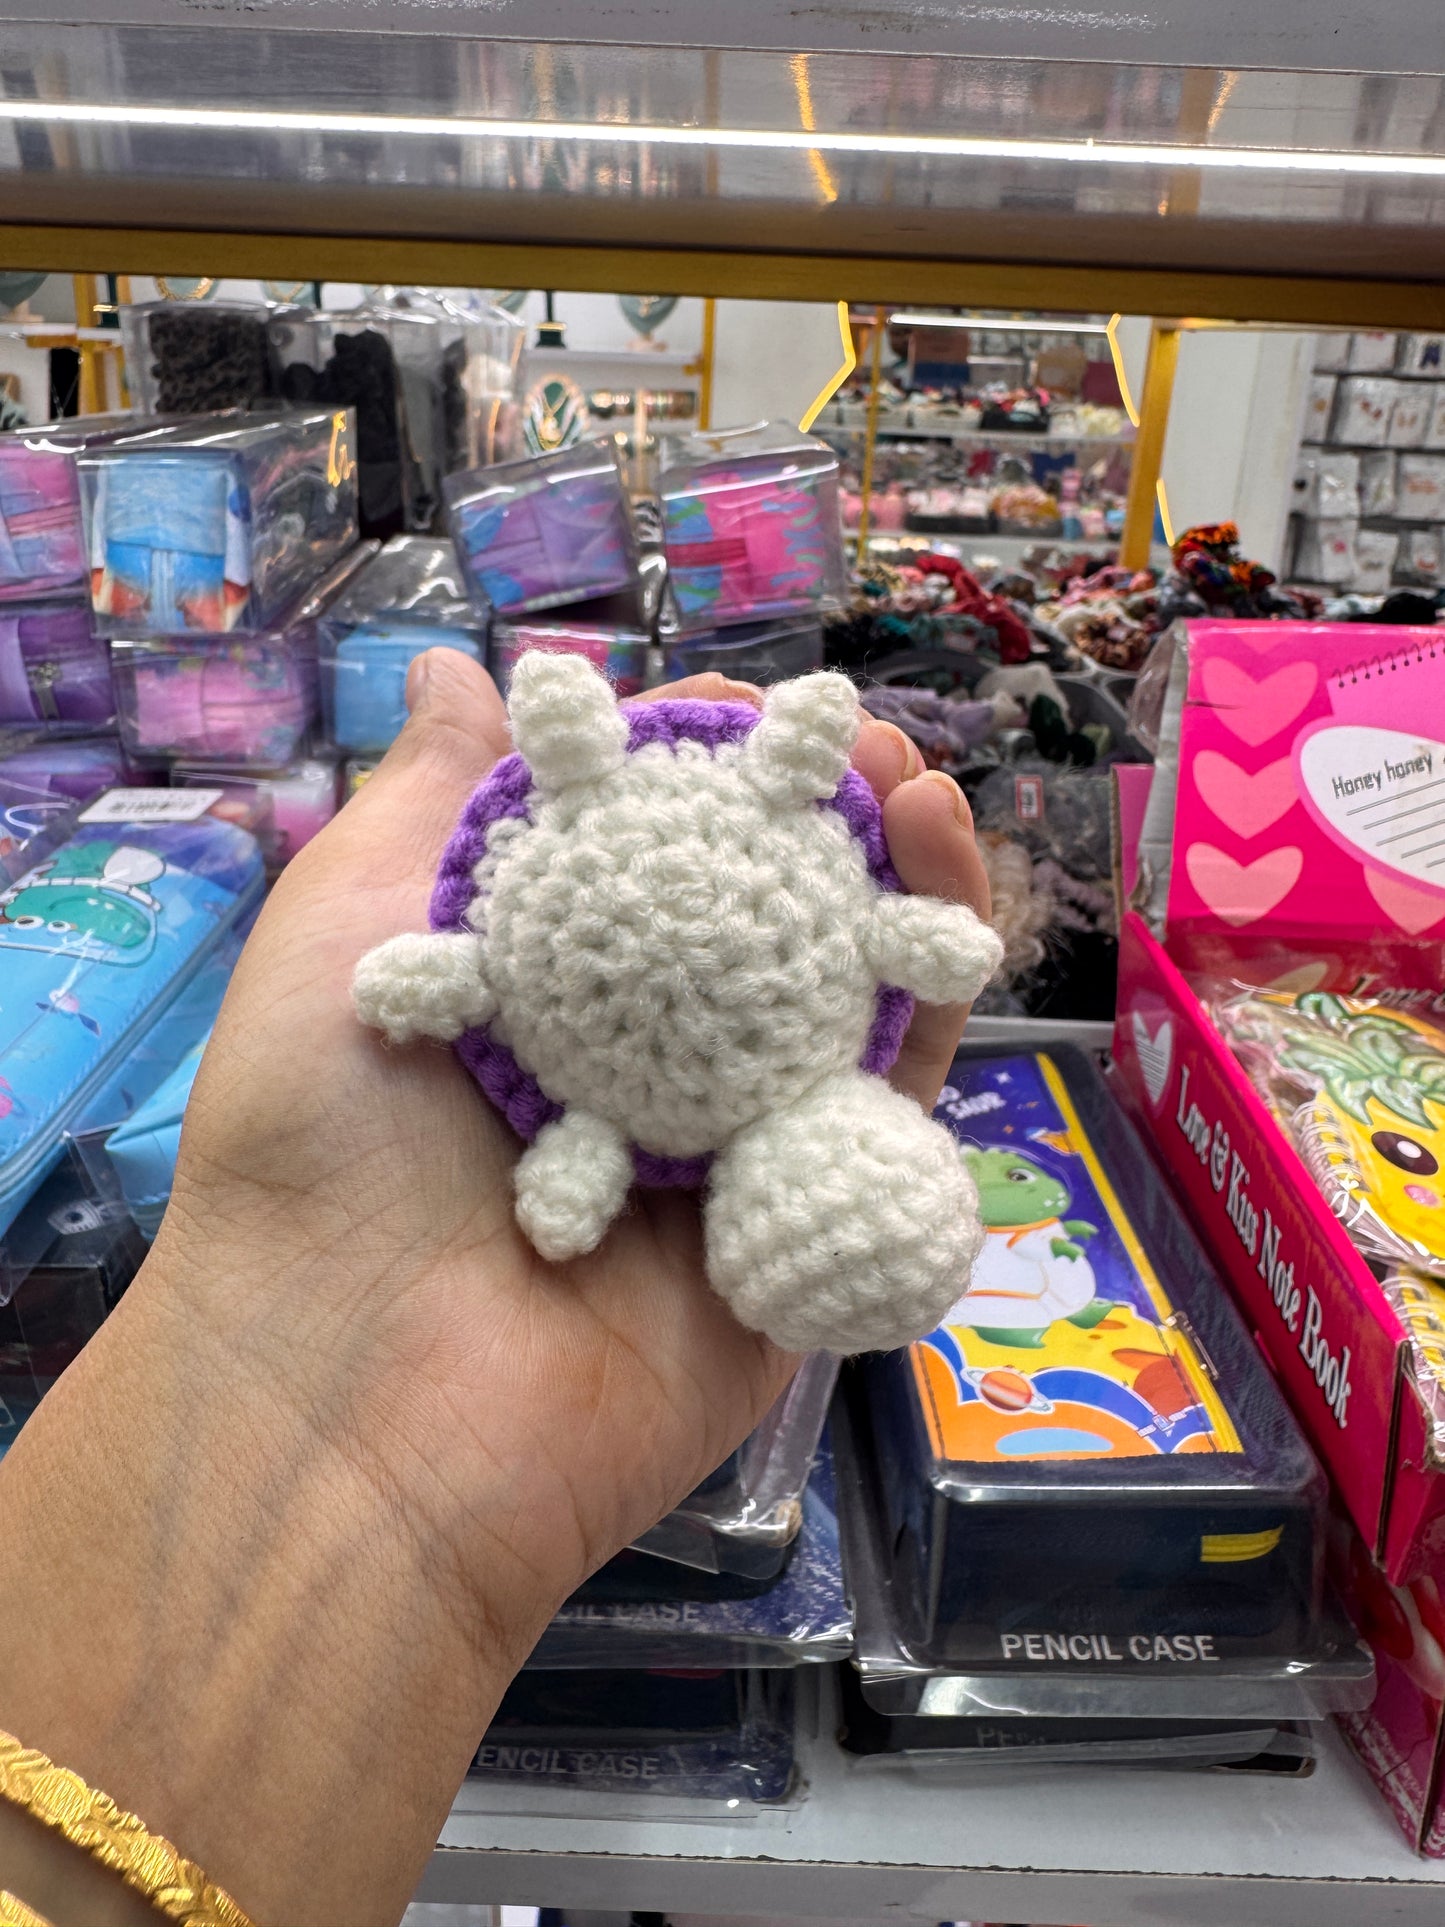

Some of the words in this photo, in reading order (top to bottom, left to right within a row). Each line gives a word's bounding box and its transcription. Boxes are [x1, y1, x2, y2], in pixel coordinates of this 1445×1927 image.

[1332, 769, 1381, 799] Honey
[1384, 752, 1433, 782] honey
[1176, 1064, 1211, 1166] Love
[1210, 1120, 1230, 1193] &
[1226, 1150, 1259, 1256] Kiss
[1257, 1208, 1302, 1333] Note
[1299, 1284, 1352, 1430] Book
[1000, 1633, 1124, 1662] PENCIL
[1129, 1635, 1221, 1662] CASE
[477, 1745, 568, 1774] ENCIL
[576, 1752, 661, 1780] CASE
